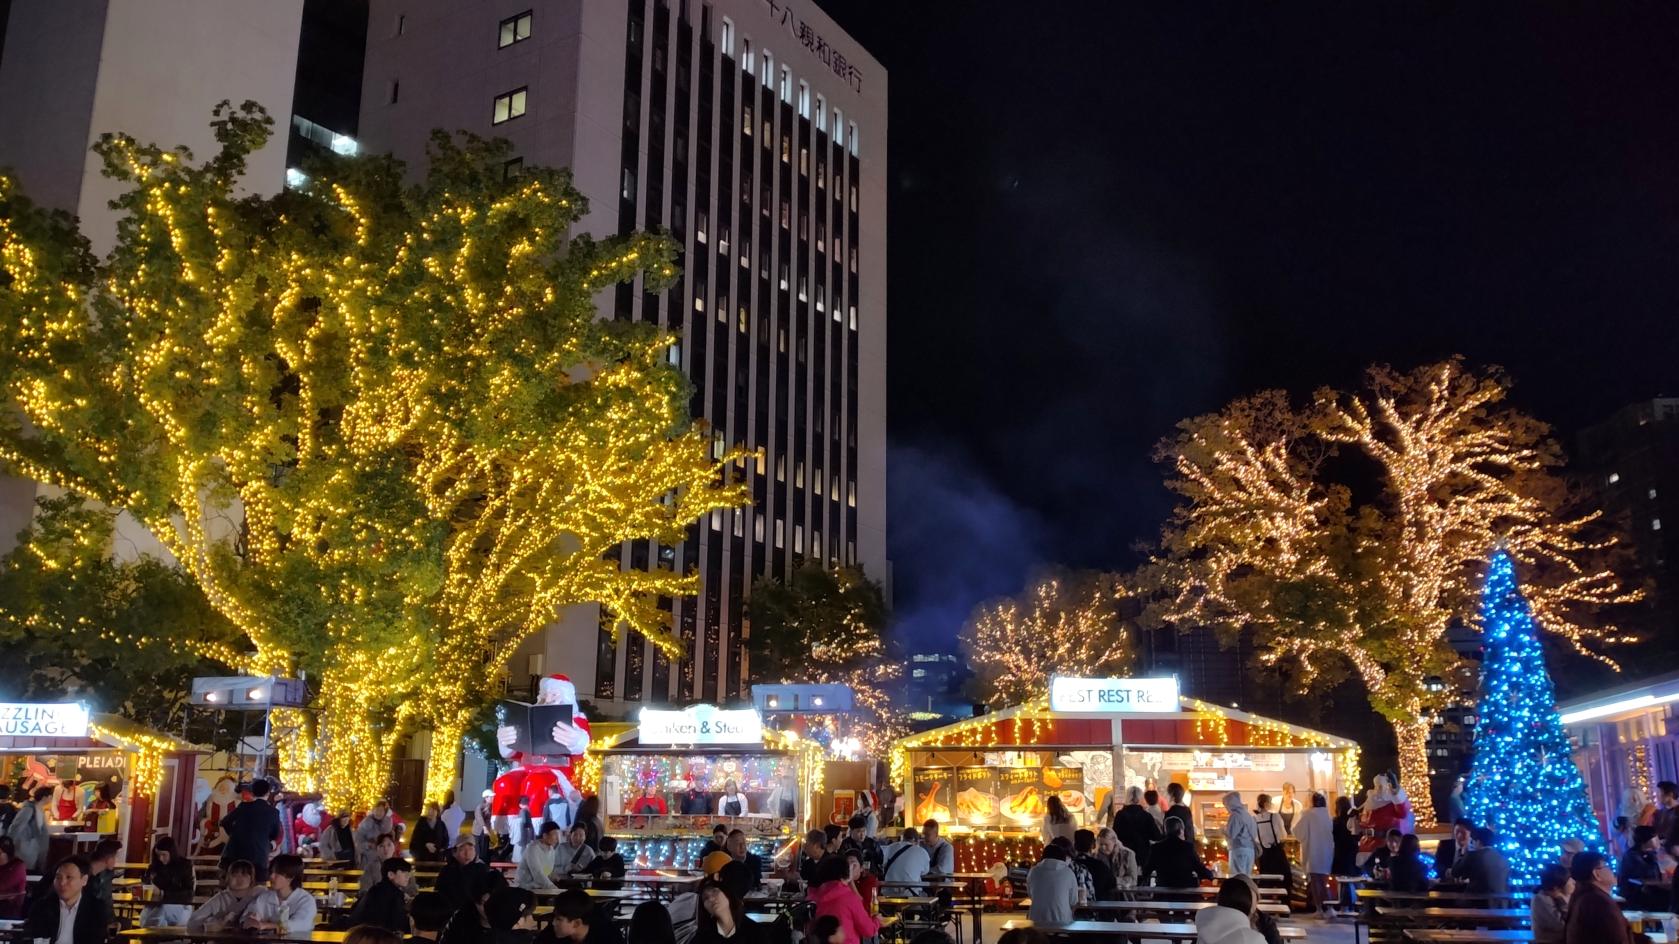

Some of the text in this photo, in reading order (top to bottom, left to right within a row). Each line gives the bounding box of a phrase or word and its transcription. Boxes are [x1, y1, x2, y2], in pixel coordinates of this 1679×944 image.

[766, 0, 862, 94] 十八親和銀行
[1098, 689, 1132, 703] REST
[1, 707, 60, 720] ZZLIN
[700, 720, 711, 734] &
